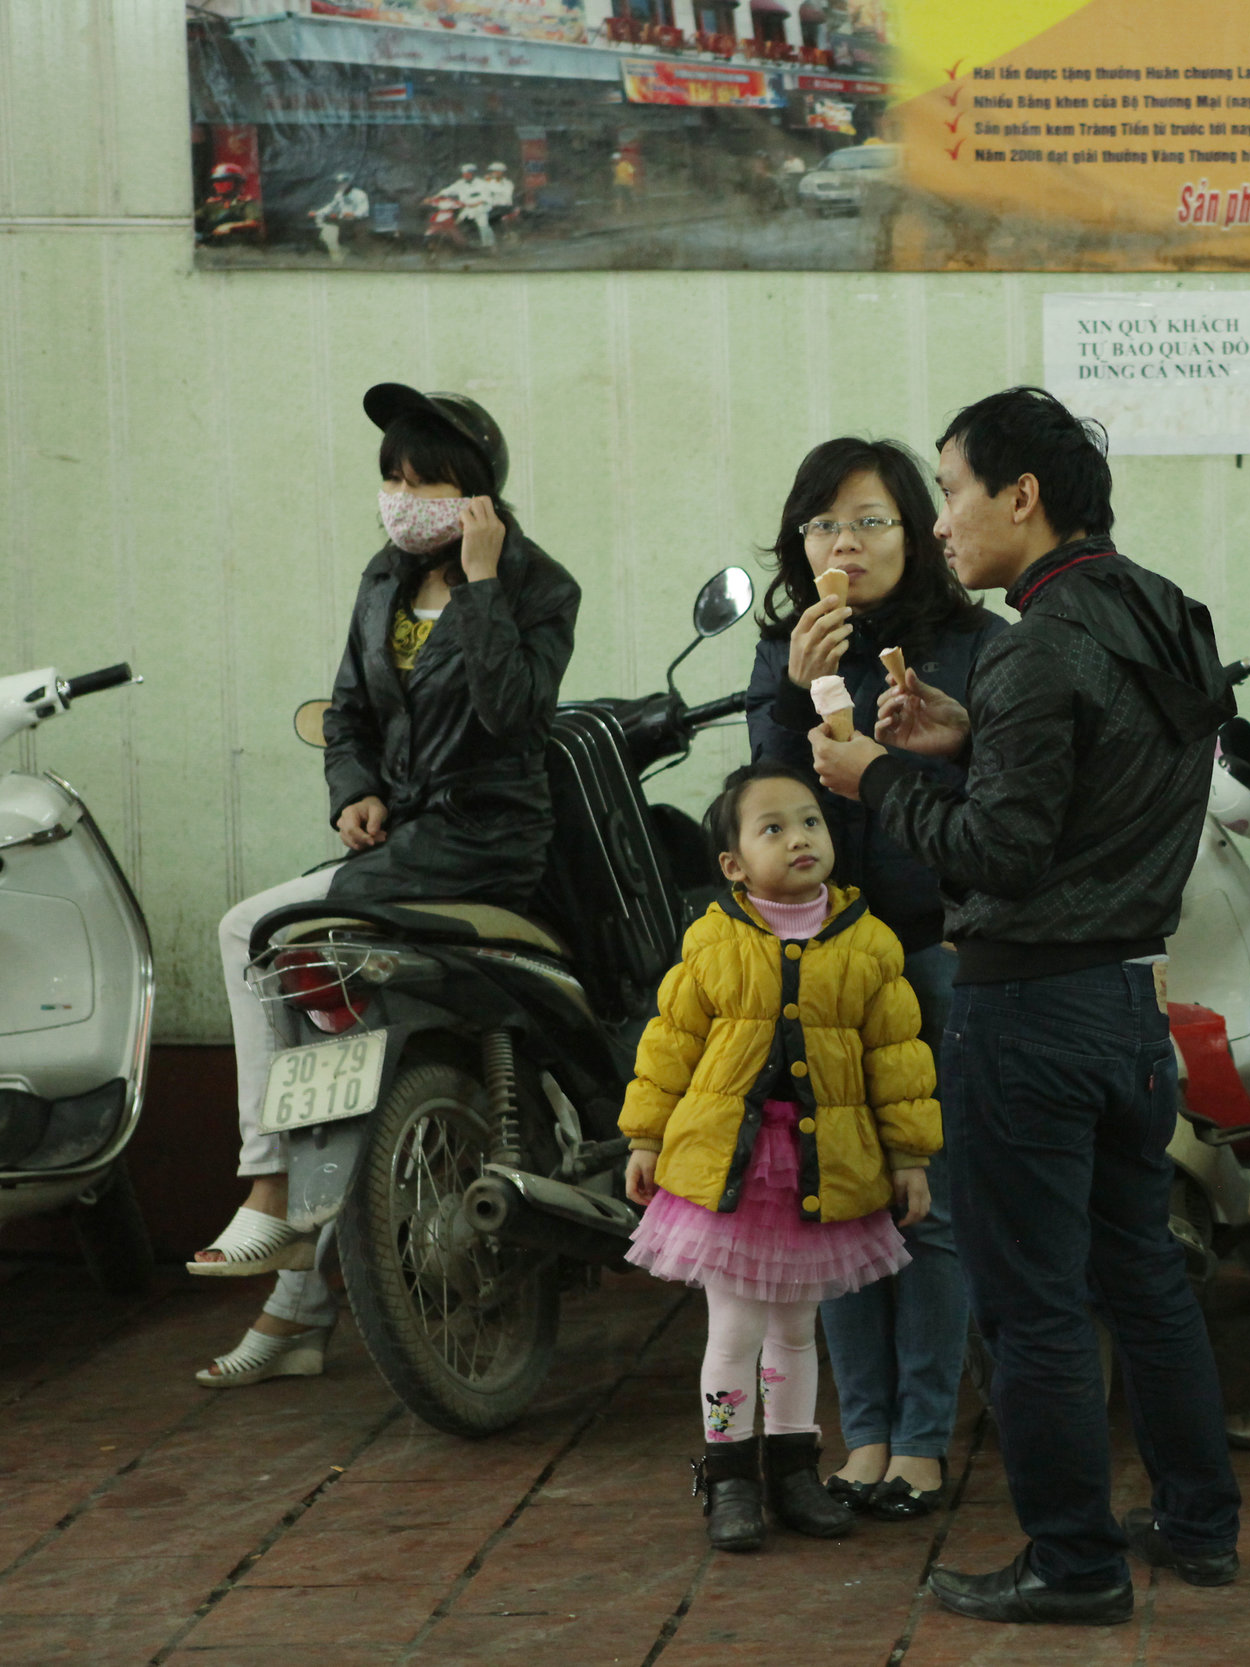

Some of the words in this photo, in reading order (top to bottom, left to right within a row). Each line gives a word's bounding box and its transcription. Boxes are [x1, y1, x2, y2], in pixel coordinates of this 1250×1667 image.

[972, 66, 995, 80] Hai
[1055, 96, 1088, 109] khen
[1045, 123, 1075, 136] kem
[1178, 177, 1219, 223] Sản
[1078, 319, 1112, 334] XIN
[1118, 315, 1160, 338] QUÝ
[1168, 315, 1239, 333] KHÁCH
[1141, 360, 1168, 379] CÁ
[1175, 359, 1231, 378] NHÂN
[282, 1041, 369, 1087] 30-Z9
[276, 1078, 361, 1125] 6310
